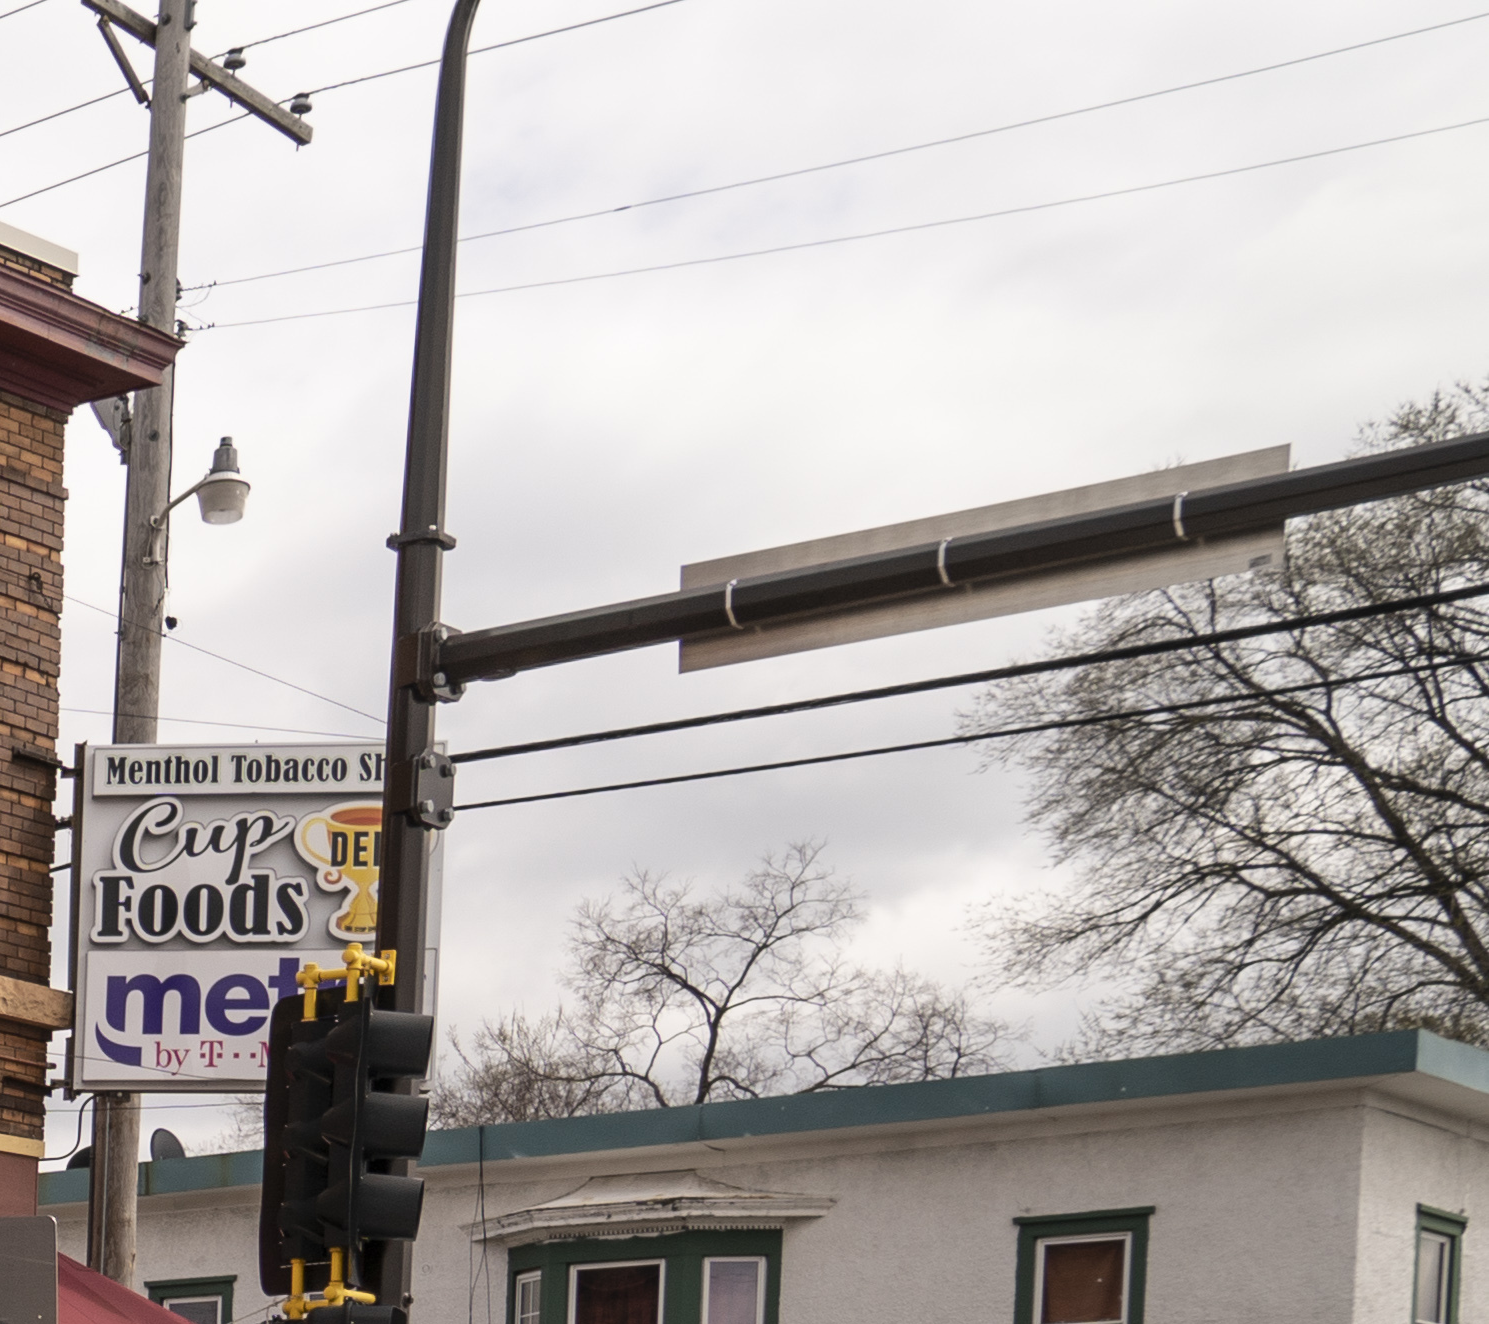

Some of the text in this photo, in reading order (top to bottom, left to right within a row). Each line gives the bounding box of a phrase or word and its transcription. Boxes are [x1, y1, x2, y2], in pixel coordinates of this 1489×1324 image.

[106, 754, 220, 785] Menthol
[231, 753, 347, 784] Tobacco
[119, 802, 290, 885] Cup
[97, 874, 306, 937] Foods
[154, 1041, 190, 1076] by
